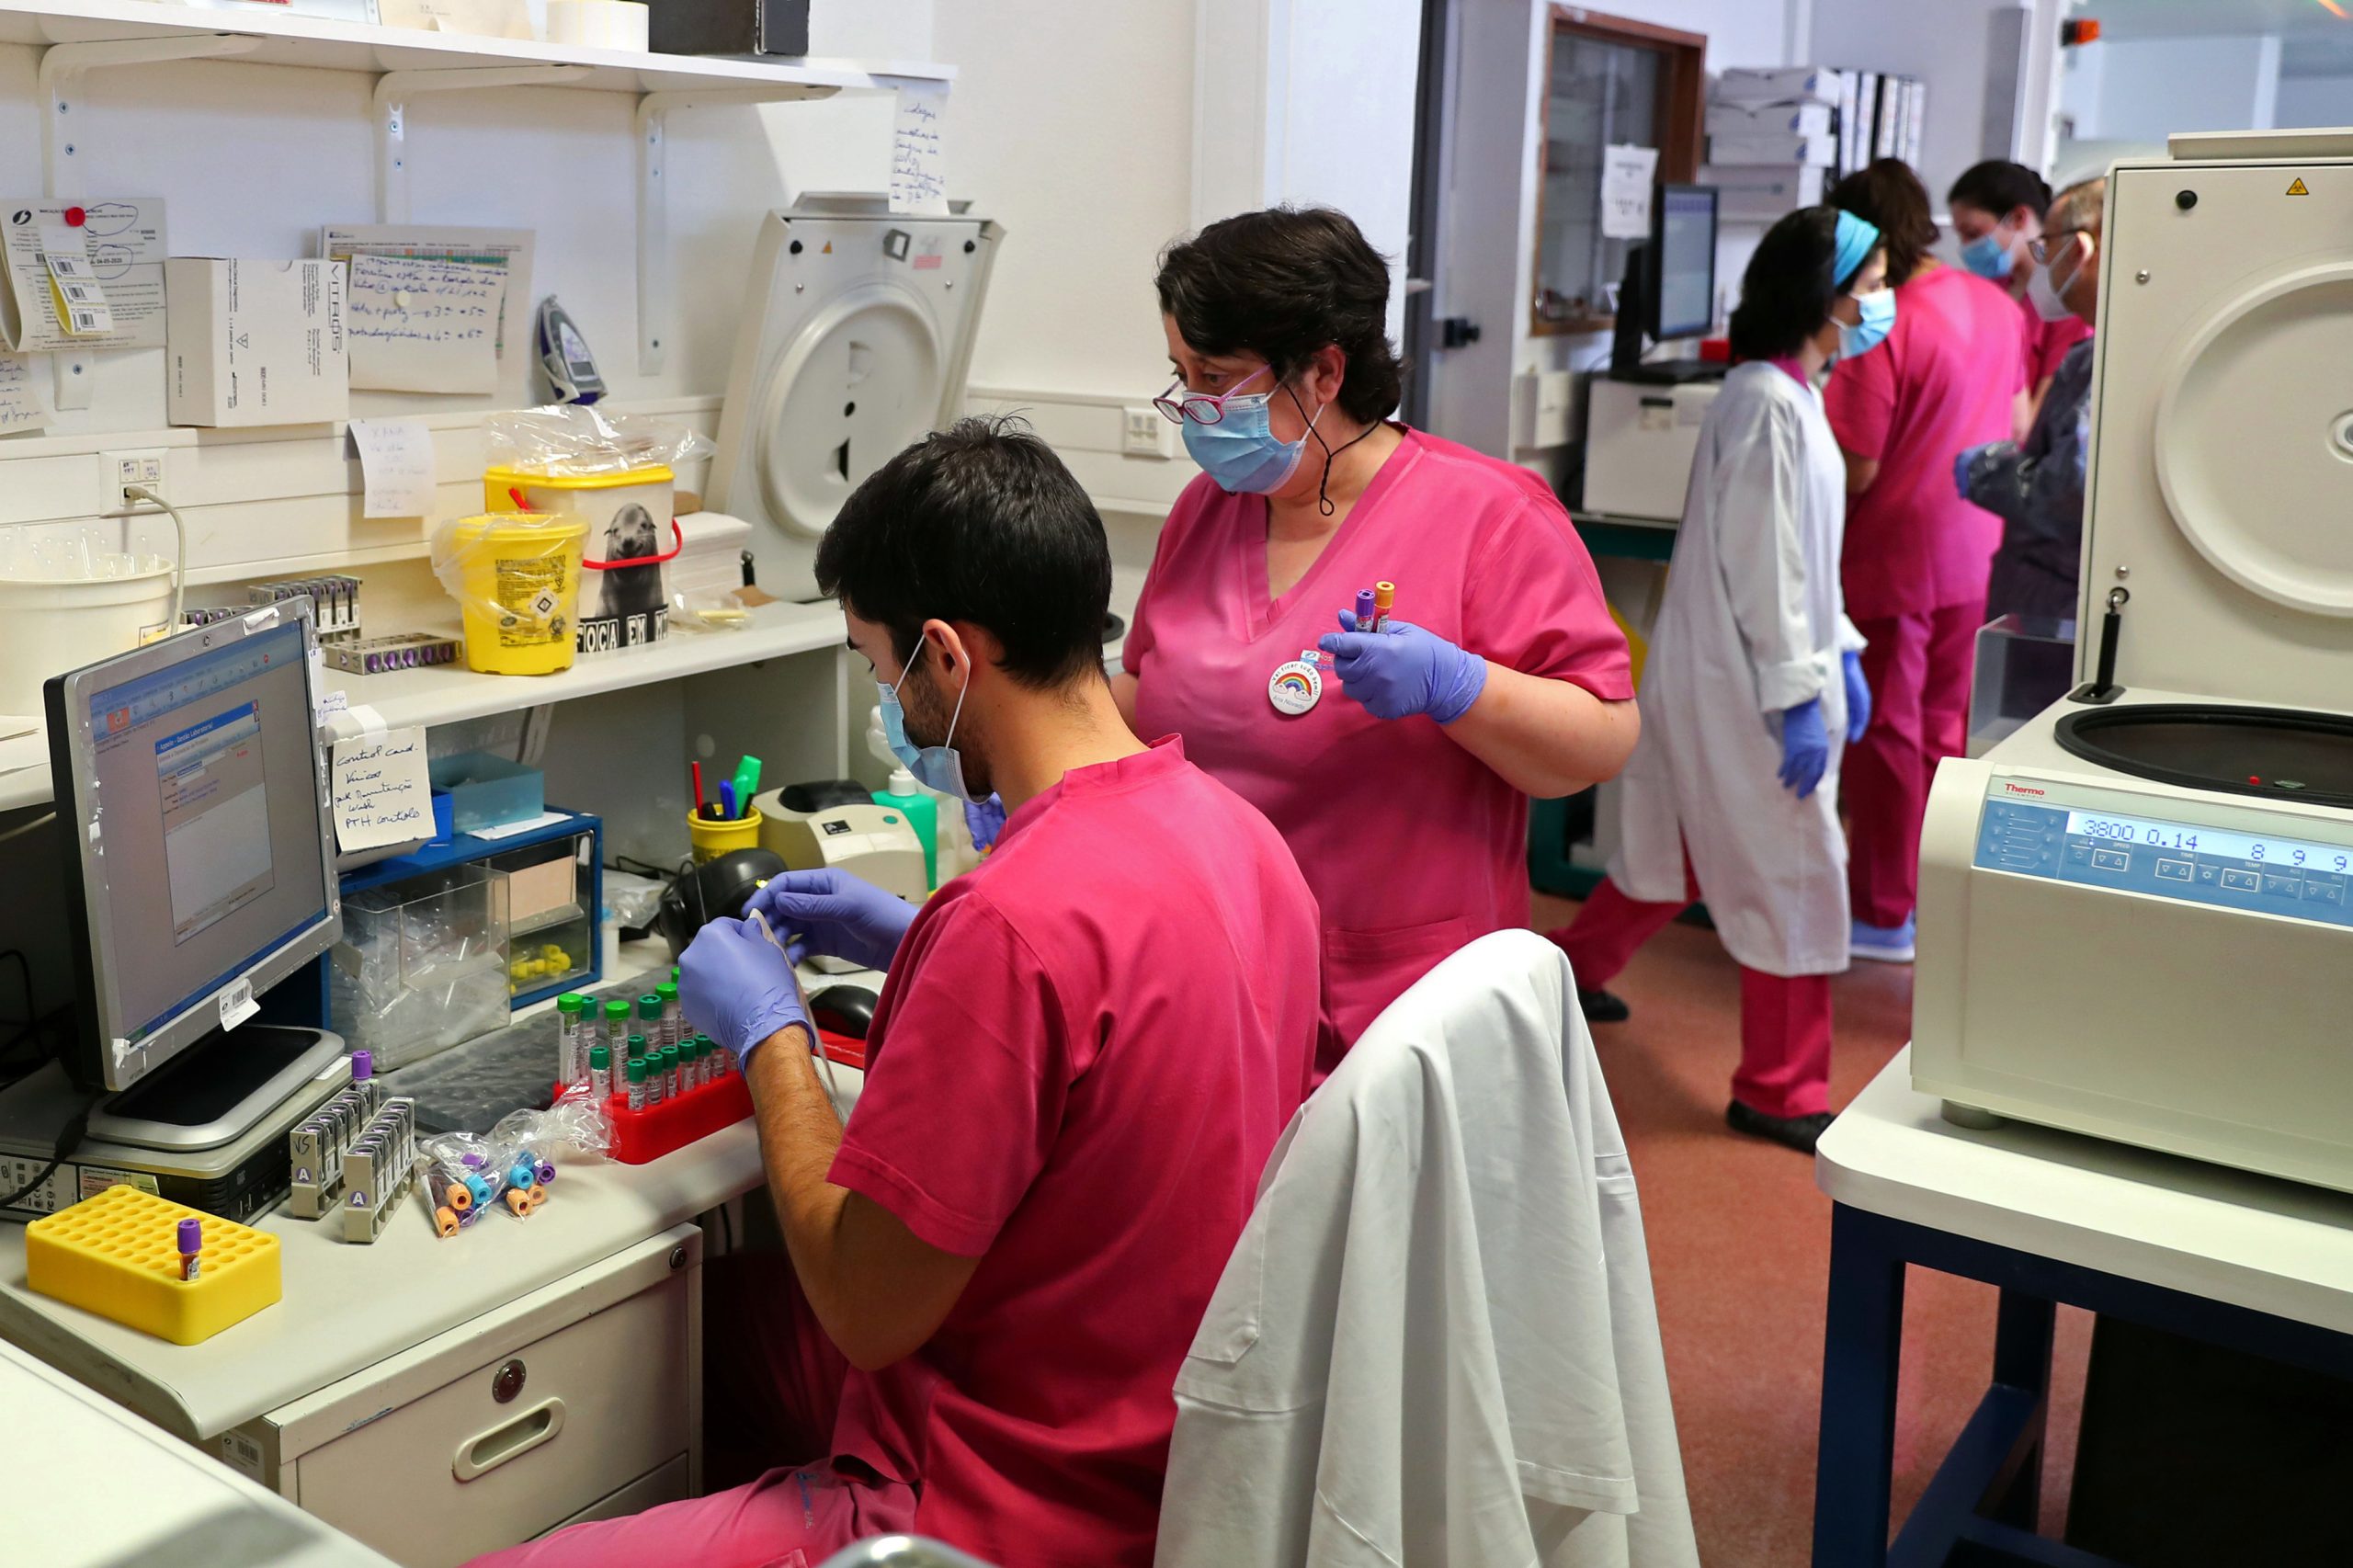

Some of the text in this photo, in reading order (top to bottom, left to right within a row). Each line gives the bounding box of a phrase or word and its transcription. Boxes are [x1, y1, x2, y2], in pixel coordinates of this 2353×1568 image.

[576, 619, 619, 652] FOCA
[627, 614, 647, 646] EM
[2005, 783, 2045, 795] Thermo
[2084, 820, 2347, 872] 3800 0.14 8 9 9
[298, 1168, 310, 1181] A
[352, 1191, 365, 1205] A
